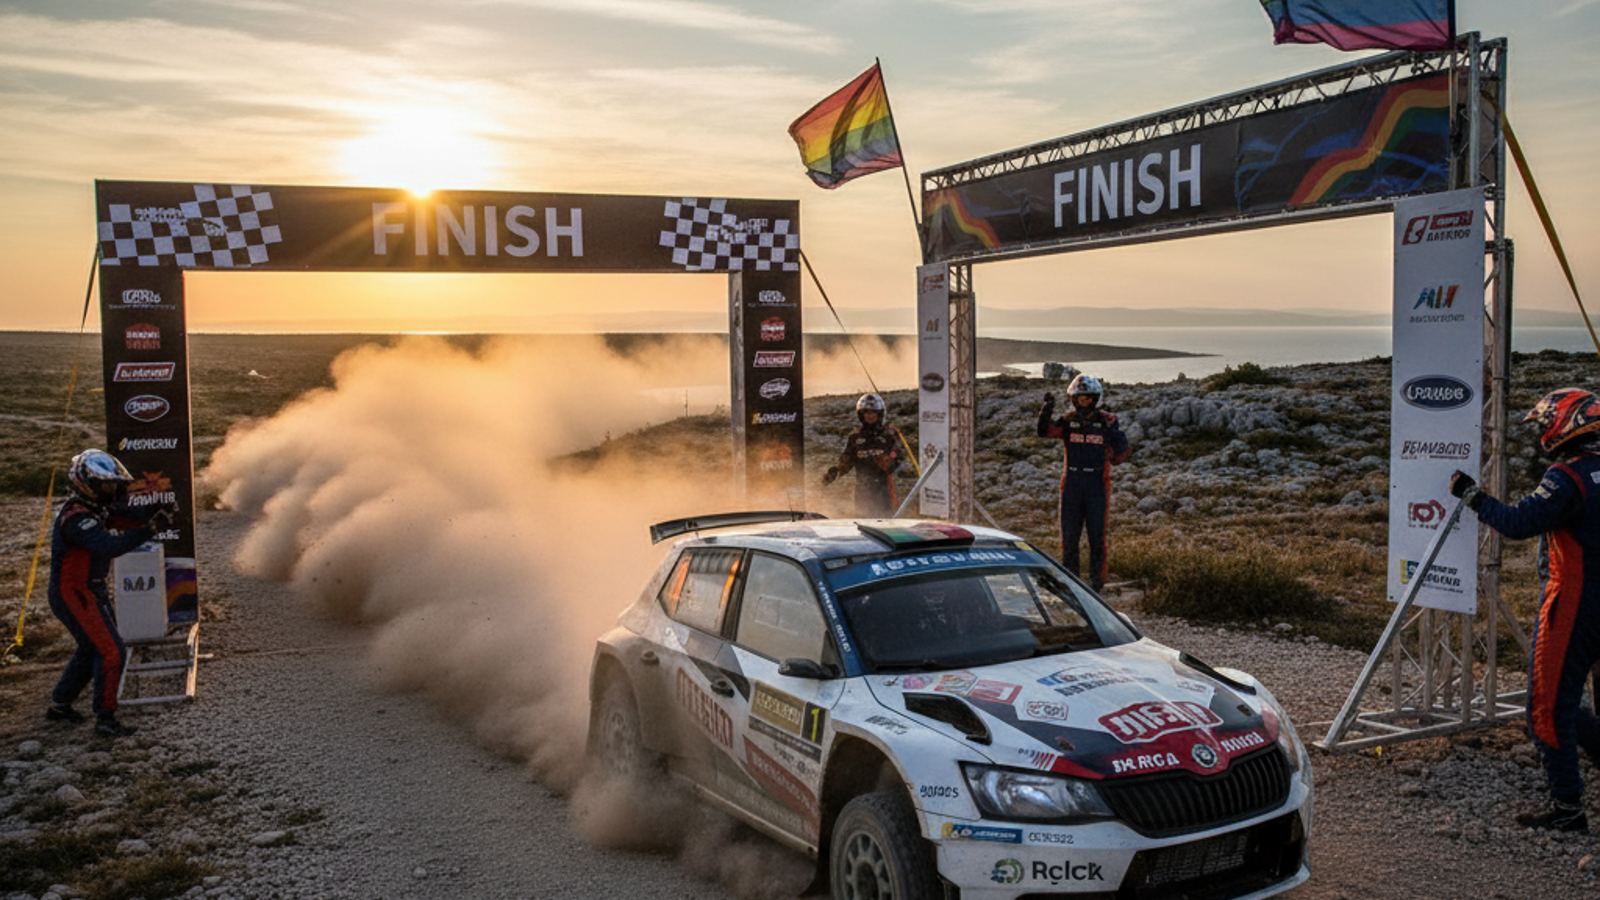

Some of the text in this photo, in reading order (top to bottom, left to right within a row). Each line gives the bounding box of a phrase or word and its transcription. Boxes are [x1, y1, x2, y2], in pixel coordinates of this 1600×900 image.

[1054, 144, 1201, 228] FINISH
[372, 202, 584, 257] FINISH
[810, 708, 821, 744] 1
